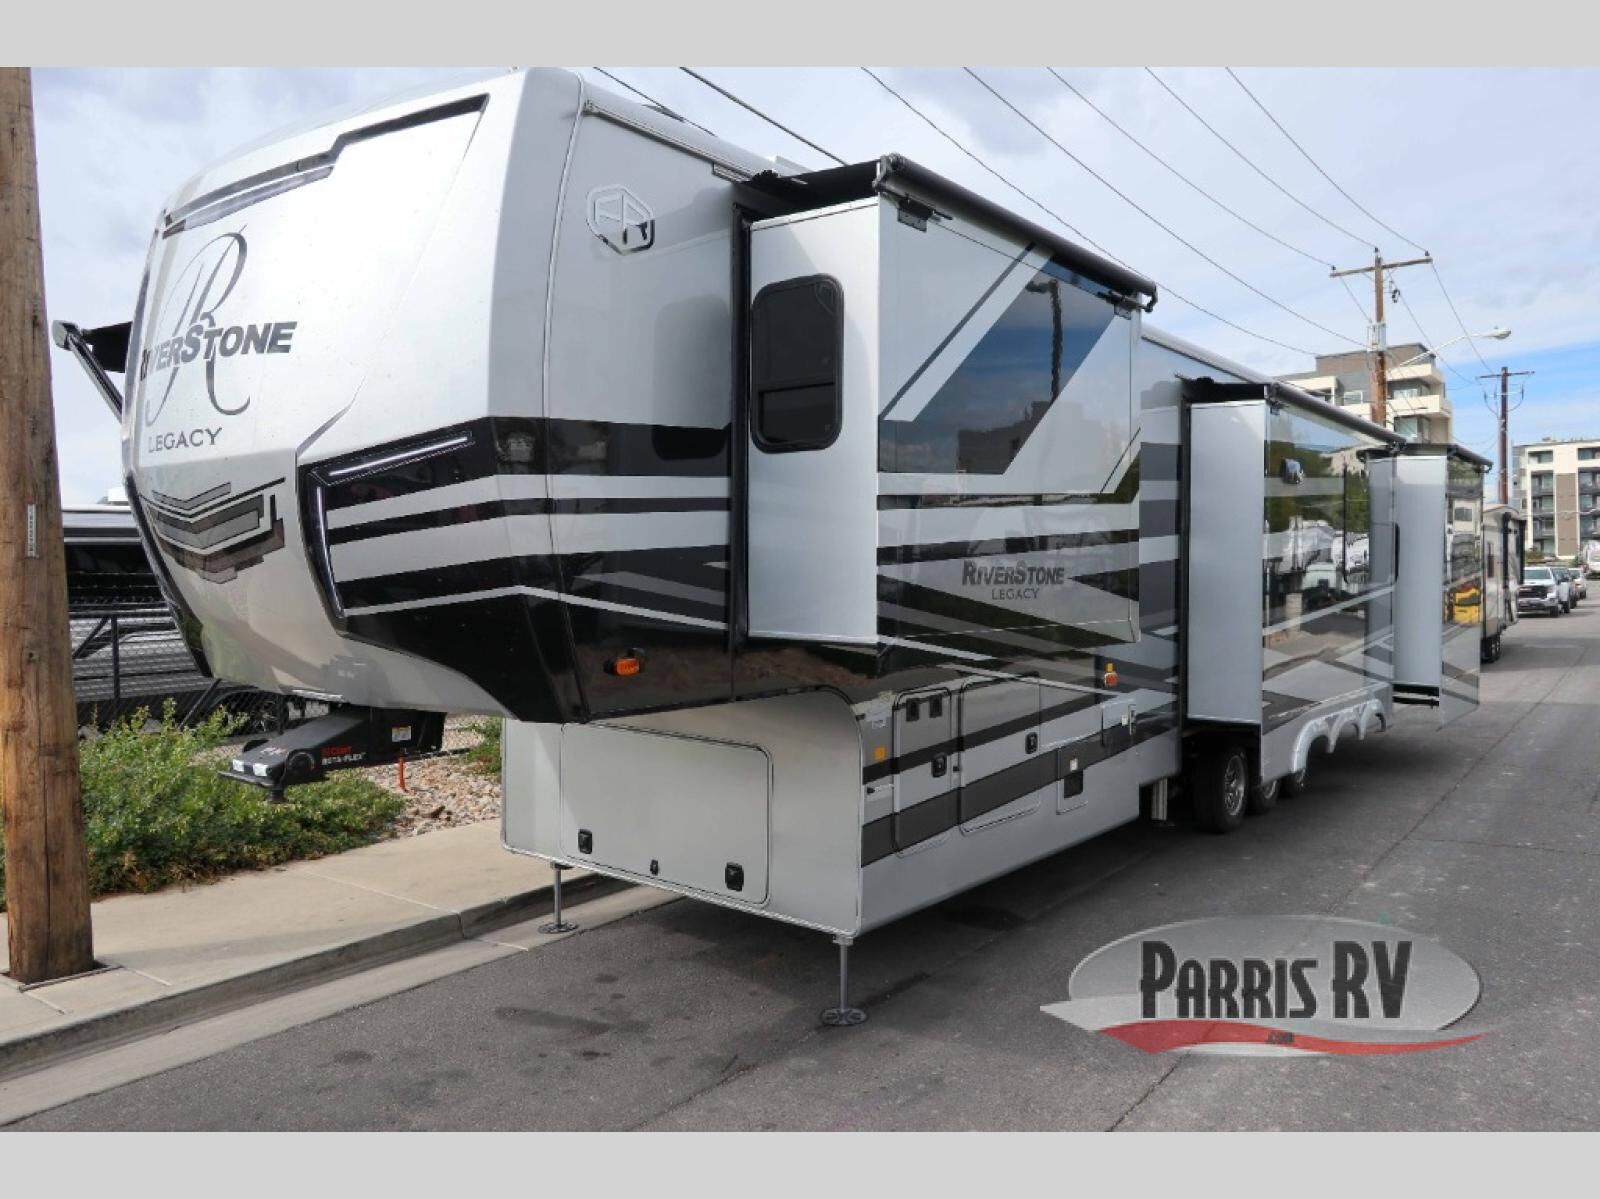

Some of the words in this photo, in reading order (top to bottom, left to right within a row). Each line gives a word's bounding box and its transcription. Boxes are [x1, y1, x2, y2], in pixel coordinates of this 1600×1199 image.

[140, 321, 298, 382] RERSTONE
[148, 426, 223, 453] LEGACY
[962, 559, 1065, 586] RIVERSTONE
[991, 587, 1040, 601] LEGACY
